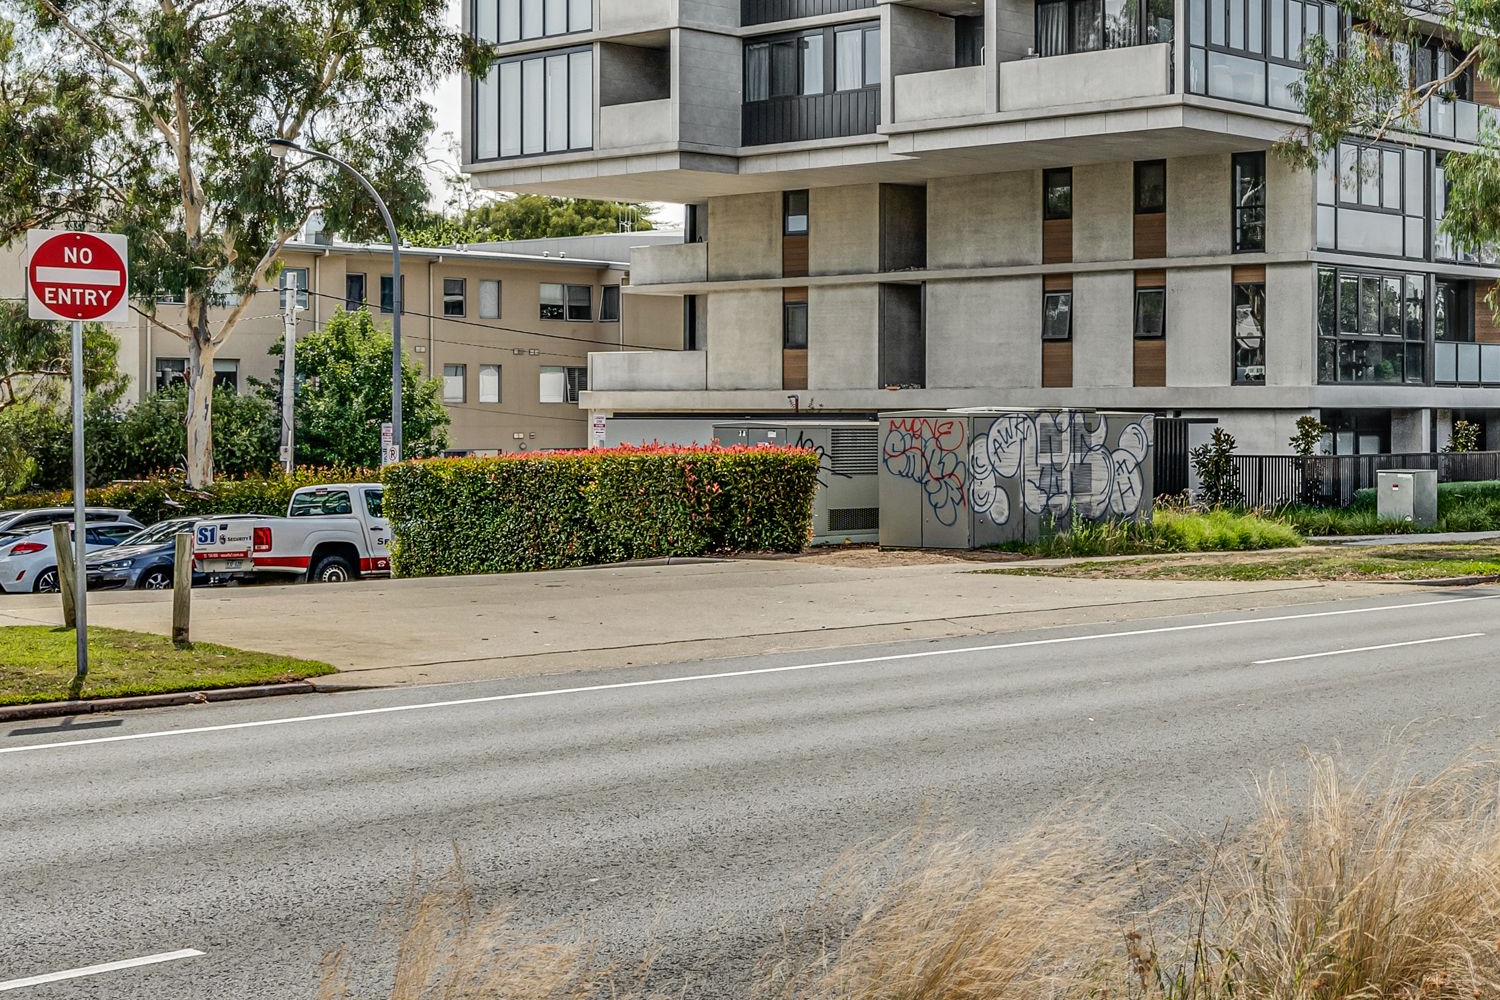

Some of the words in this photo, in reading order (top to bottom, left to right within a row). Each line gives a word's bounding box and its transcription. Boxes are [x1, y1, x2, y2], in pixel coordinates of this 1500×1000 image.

[64, 246, 93, 264] NO
[44, 287, 112, 306] ENTRY
[198, 527, 216, 543] S1
